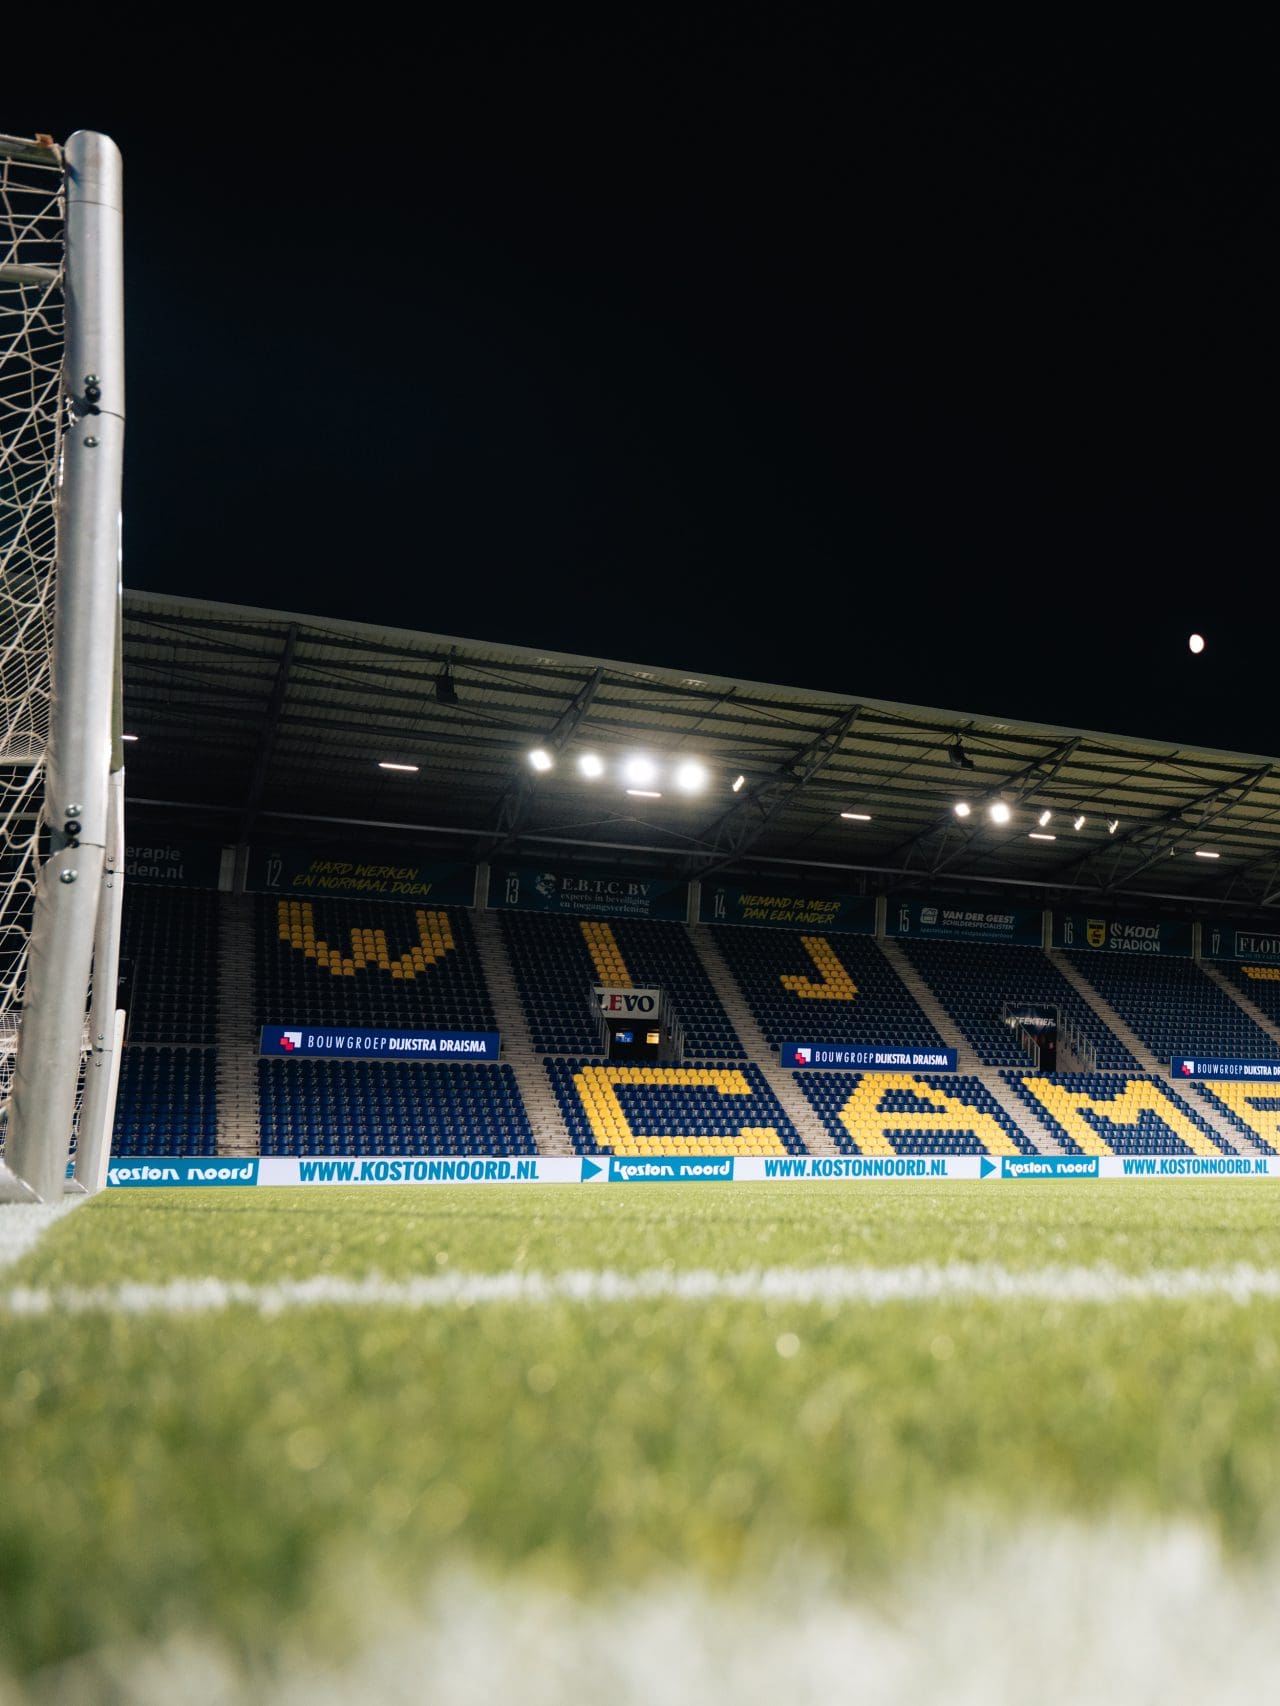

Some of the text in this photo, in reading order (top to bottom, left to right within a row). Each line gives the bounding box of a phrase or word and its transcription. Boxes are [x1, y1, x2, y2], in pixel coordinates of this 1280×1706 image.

[265, 859, 283, 887] 12
[310, 860, 419, 880] HARD WERKEN
[293, 874, 432, 895] EN NORMAAL DOEN
[505, 878, 520, 904] 13
[562, 878, 650, 896] E.B.T.C. BV
[714, 894, 726, 918] 14
[738, 895, 841, 911] NIEMAND IS MEER
[742, 907, 835, 923] DAN EEN ANDER
[899, 909, 910, 932] 15
[942, 910, 963, 920] VAN
[965, 912, 985, 922] DER
[986, 914, 1015, 924] GEEST
[1064, 922, 1074, 944] 16
[1110, 938, 1160, 952] STADION
[1212, 934, 1220, 954] 17
[308, 1035, 486, 1052] BOUWGROEP DIJKSTRA DRAISMA
[815, 1051, 948, 1066] BOUWGROEP DIJKSTRA DRAISMA
[1197, 1063, 1243, 1075] BOUWGROEP
[1244, 1065, 1272, 1075] DIJKSTRA
[187, 1162, 253, 1180] noord
[299, 1160, 540, 1182] WWW.KOSTONNOORD.NL
[613, 1160, 730, 1180] koston noord
[764, 1159, 948, 1177] WWW.KOSTONNOORD.NL
[1005, 1160, 1096, 1177] koston noord
[1123, 1159, 1269, 1175] WWW.KOSTONNOORD.NL
